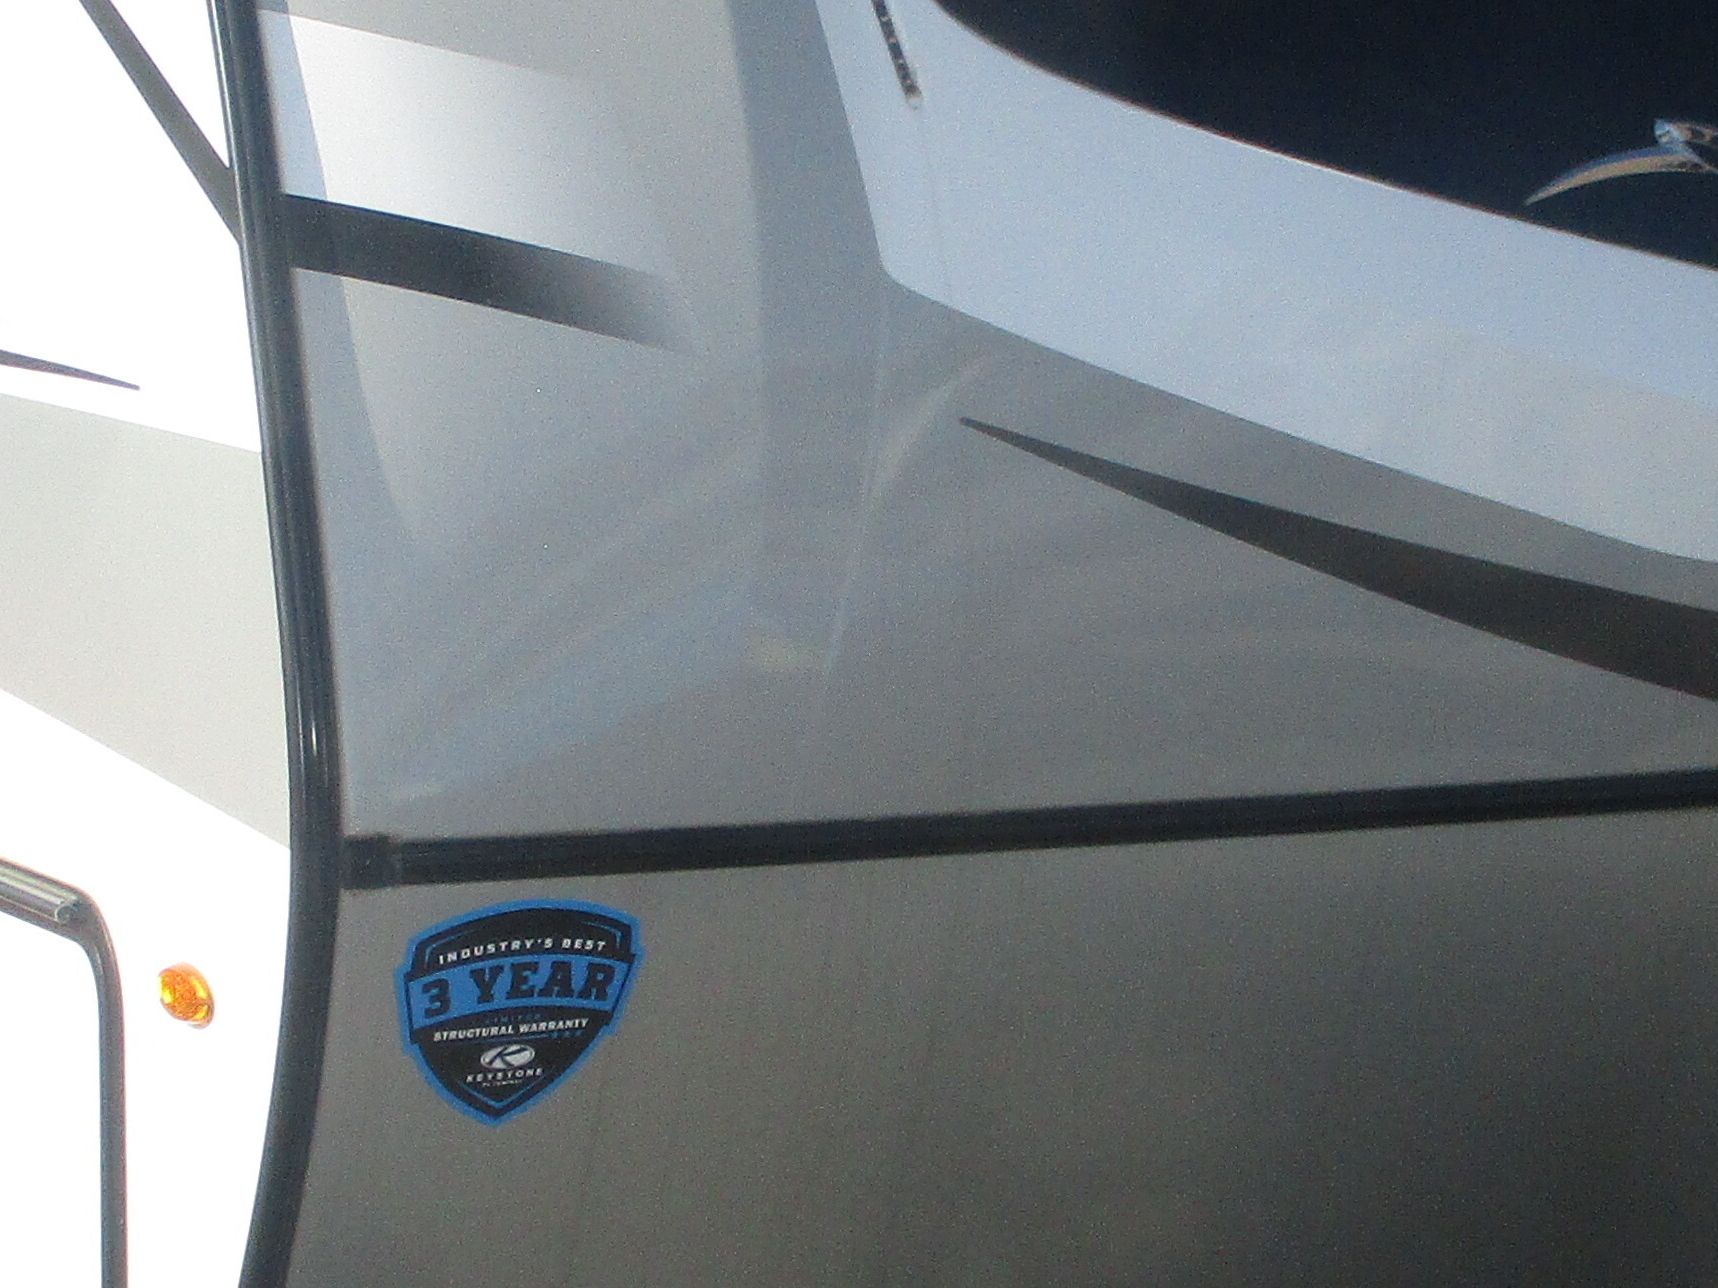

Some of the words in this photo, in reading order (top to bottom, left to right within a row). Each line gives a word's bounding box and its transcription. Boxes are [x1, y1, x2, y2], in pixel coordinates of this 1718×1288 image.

[438, 938, 554, 965] INDUSTRY'S
[561, 938, 606, 952] BEST
[421, 978, 452, 1018] 3
[469, 961, 616, 1004] YEAR
[434, 1025, 514, 1042] STRUCTURAL
[519, 1018, 589, 1034] WARRANTY
[465, 1068, 543, 1083] KEYSTONE
